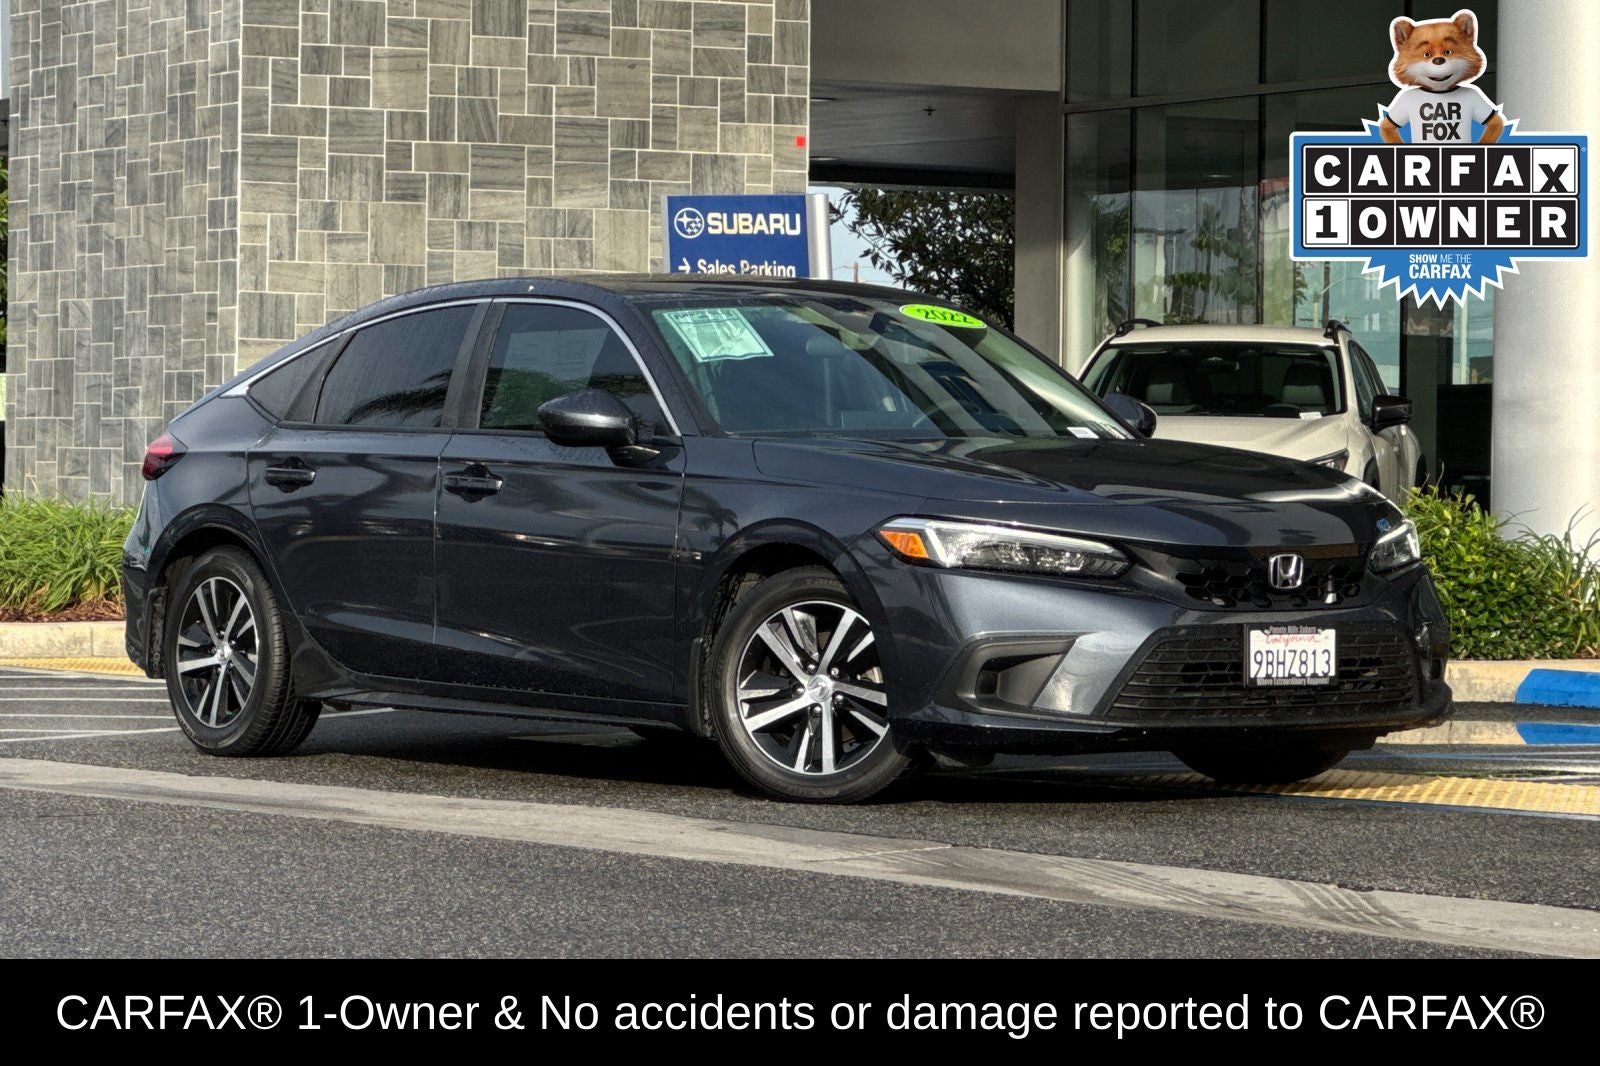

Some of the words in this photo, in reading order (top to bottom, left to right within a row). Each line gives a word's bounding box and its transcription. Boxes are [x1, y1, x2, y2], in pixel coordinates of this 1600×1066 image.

[706, 212, 801, 236] SUBARU
[697, 259, 736, 275] Sales
[916, 308, 974, 325] 2022
[1266, 634, 1320, 647] California
[1253, 649, 1331, 678] 9BHZ813
